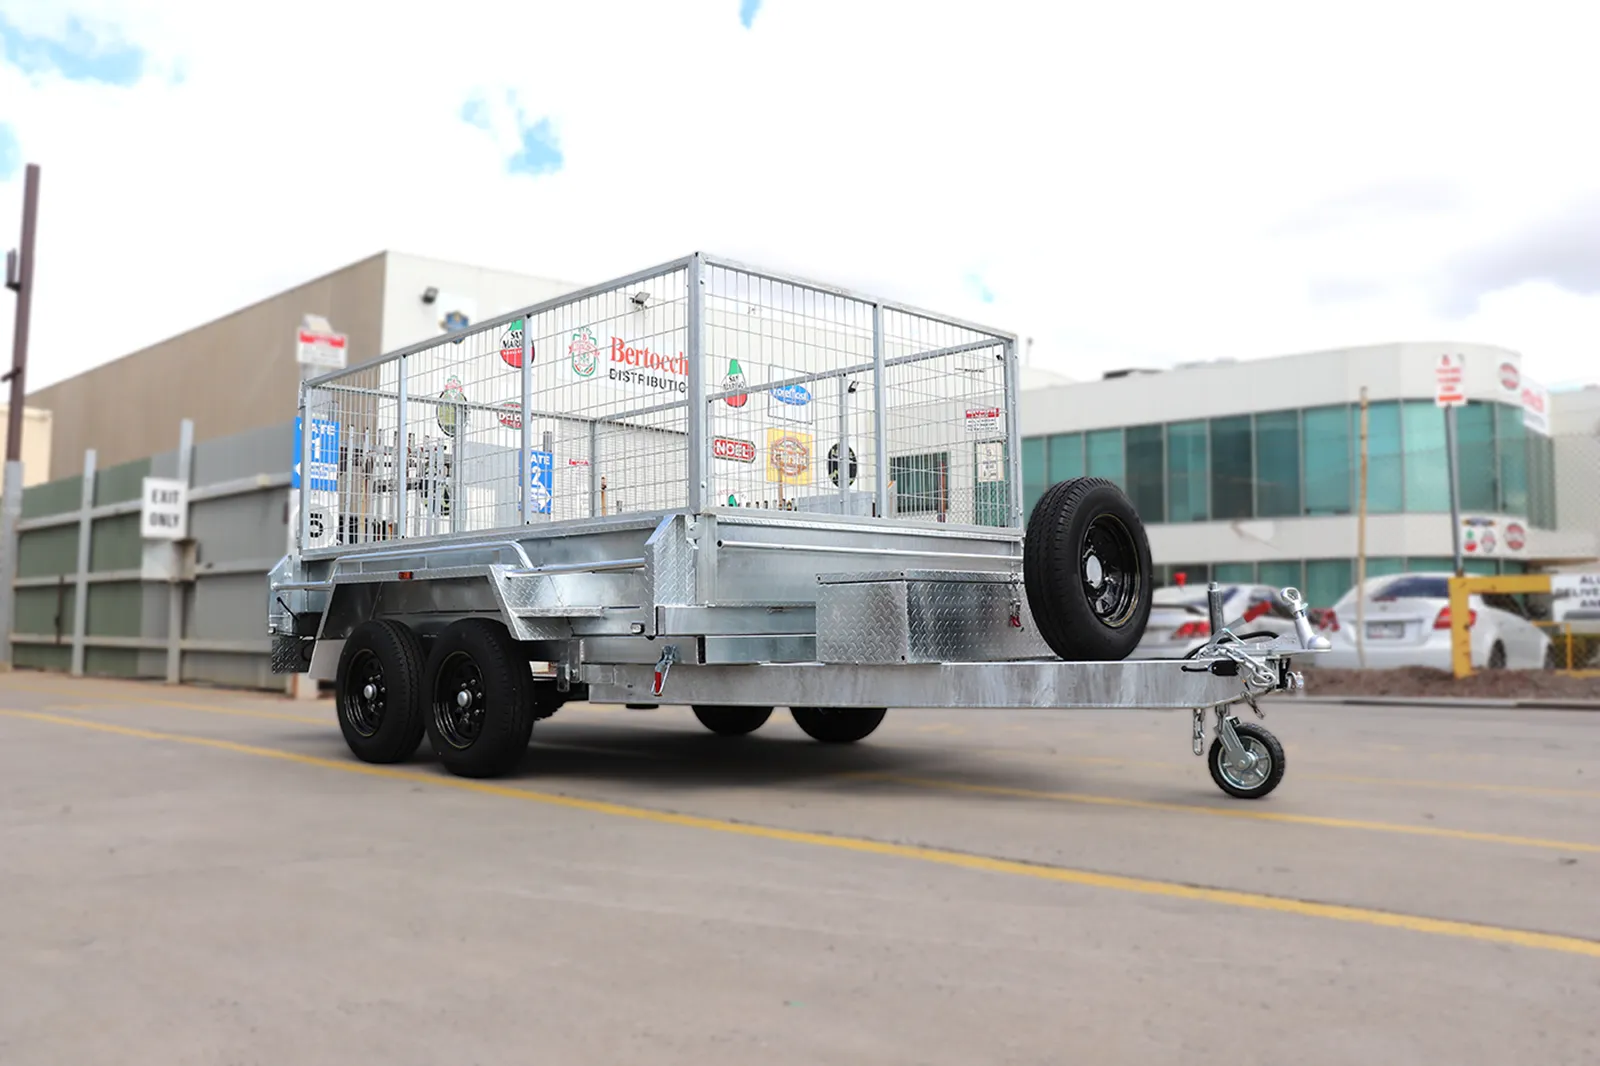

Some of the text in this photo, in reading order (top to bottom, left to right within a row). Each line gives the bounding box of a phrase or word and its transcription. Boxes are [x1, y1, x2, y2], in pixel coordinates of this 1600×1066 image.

[610, 336, 688, 376] Bertocch
[609, 368, 687, 393] DISTRIBUTIO
[716, 441, 749, 458] NOEL
[531, 454, 551, 465] ATE
[532, 466, 541, 485] 2
[151, 489, 180, 504] EXIT
[150, 512, 180, 528] ONLY
[1554, 587, 1600, 598] DELIVE
